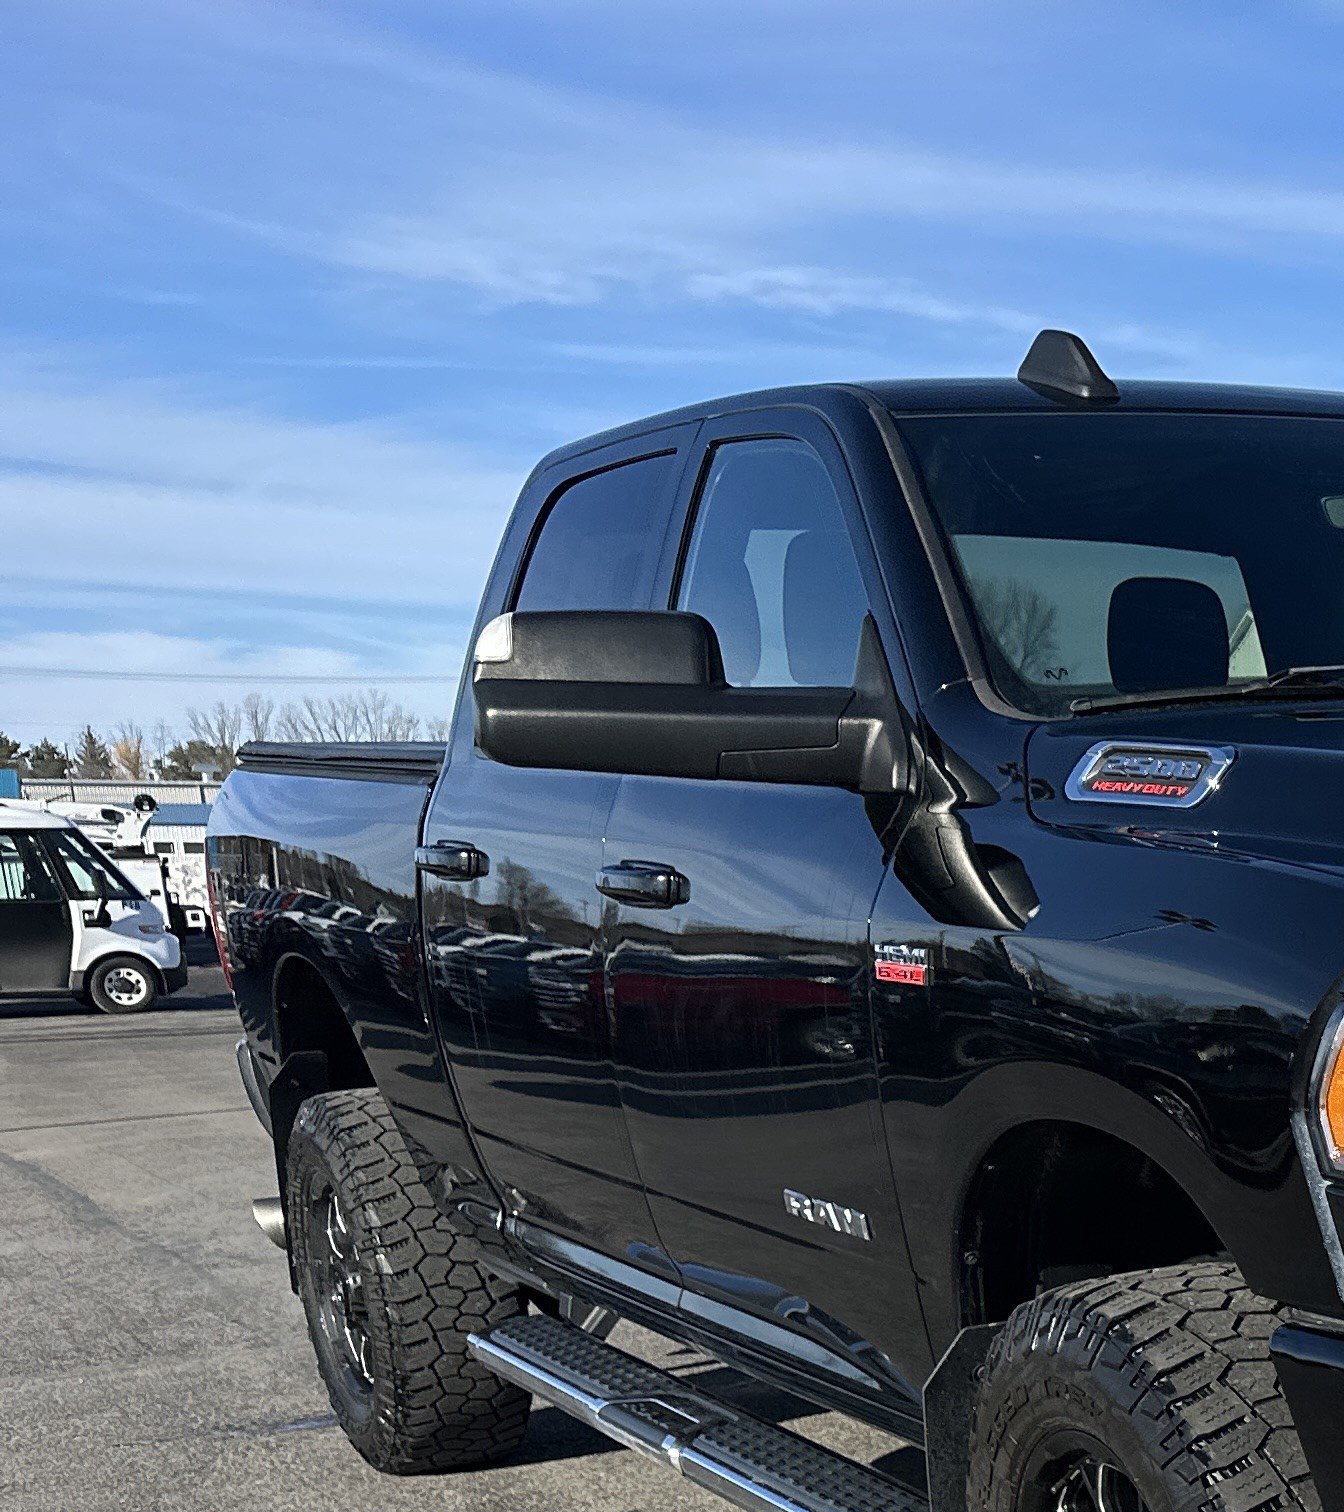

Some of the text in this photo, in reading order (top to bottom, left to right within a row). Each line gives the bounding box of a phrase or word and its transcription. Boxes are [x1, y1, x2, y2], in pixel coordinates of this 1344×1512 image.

[1102, 756, 1202, 780] 2500
[1092, 780, 1189, 798] HEAVY DUTY
[783, 1188, 871, 1241] RAM
